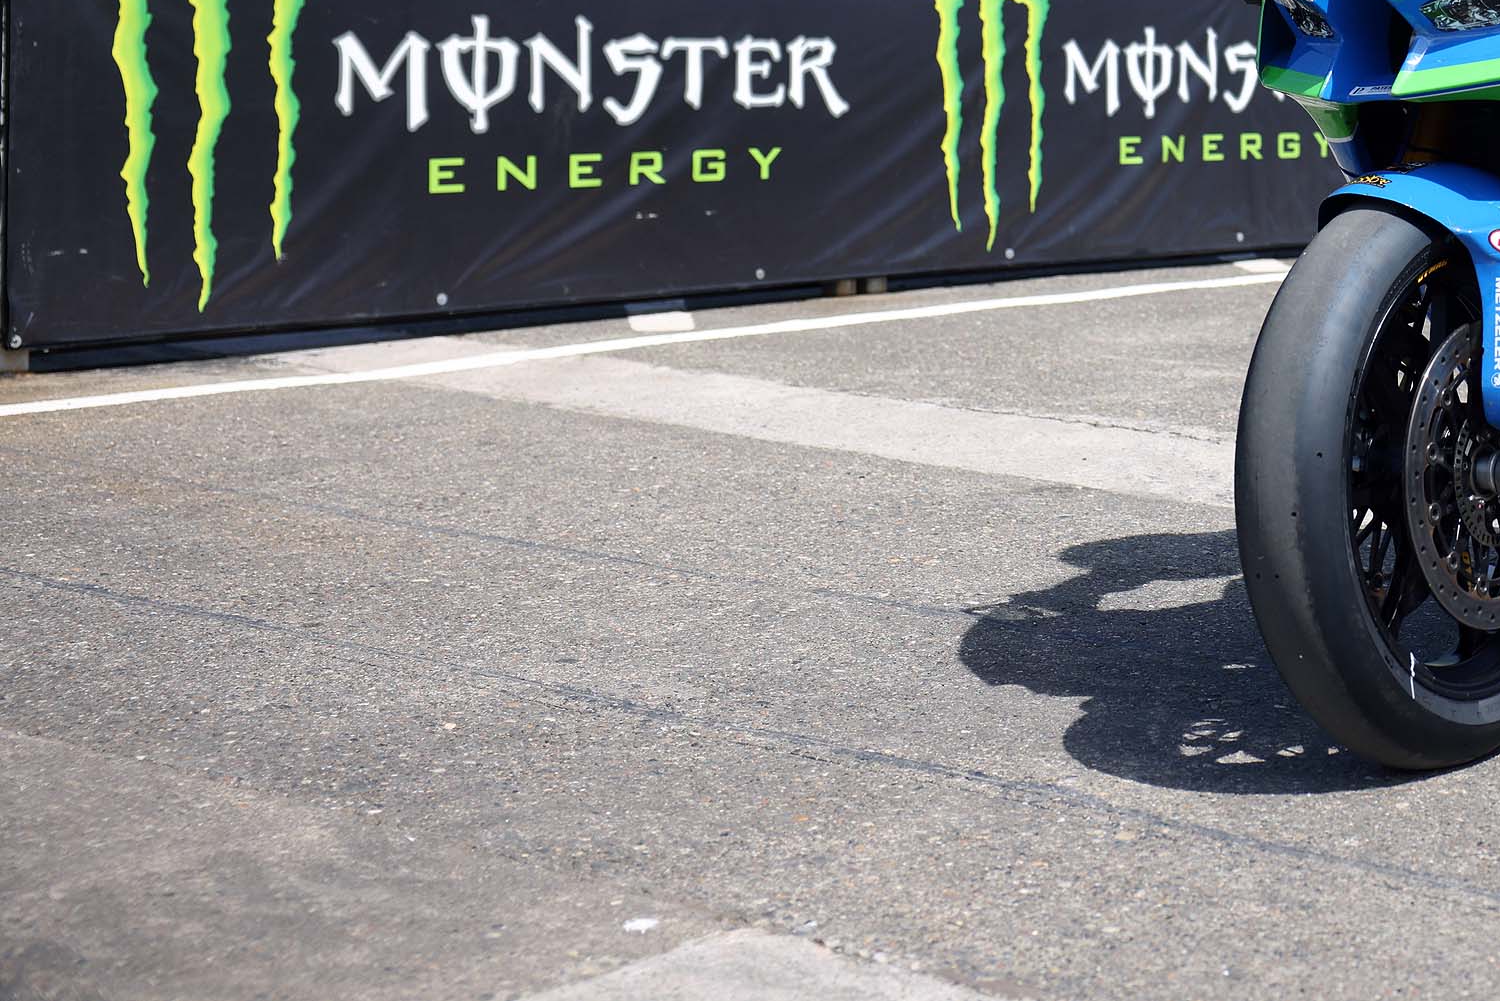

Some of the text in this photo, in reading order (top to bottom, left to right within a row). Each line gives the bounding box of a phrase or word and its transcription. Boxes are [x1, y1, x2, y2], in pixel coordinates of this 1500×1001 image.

[332, 15, 850, 133] MONSTER
[1062, 26, 1284, 119] MONS
[428, 147, 783, 194] ENERGY
[1119, 131, 1329, 165] ENERGY
